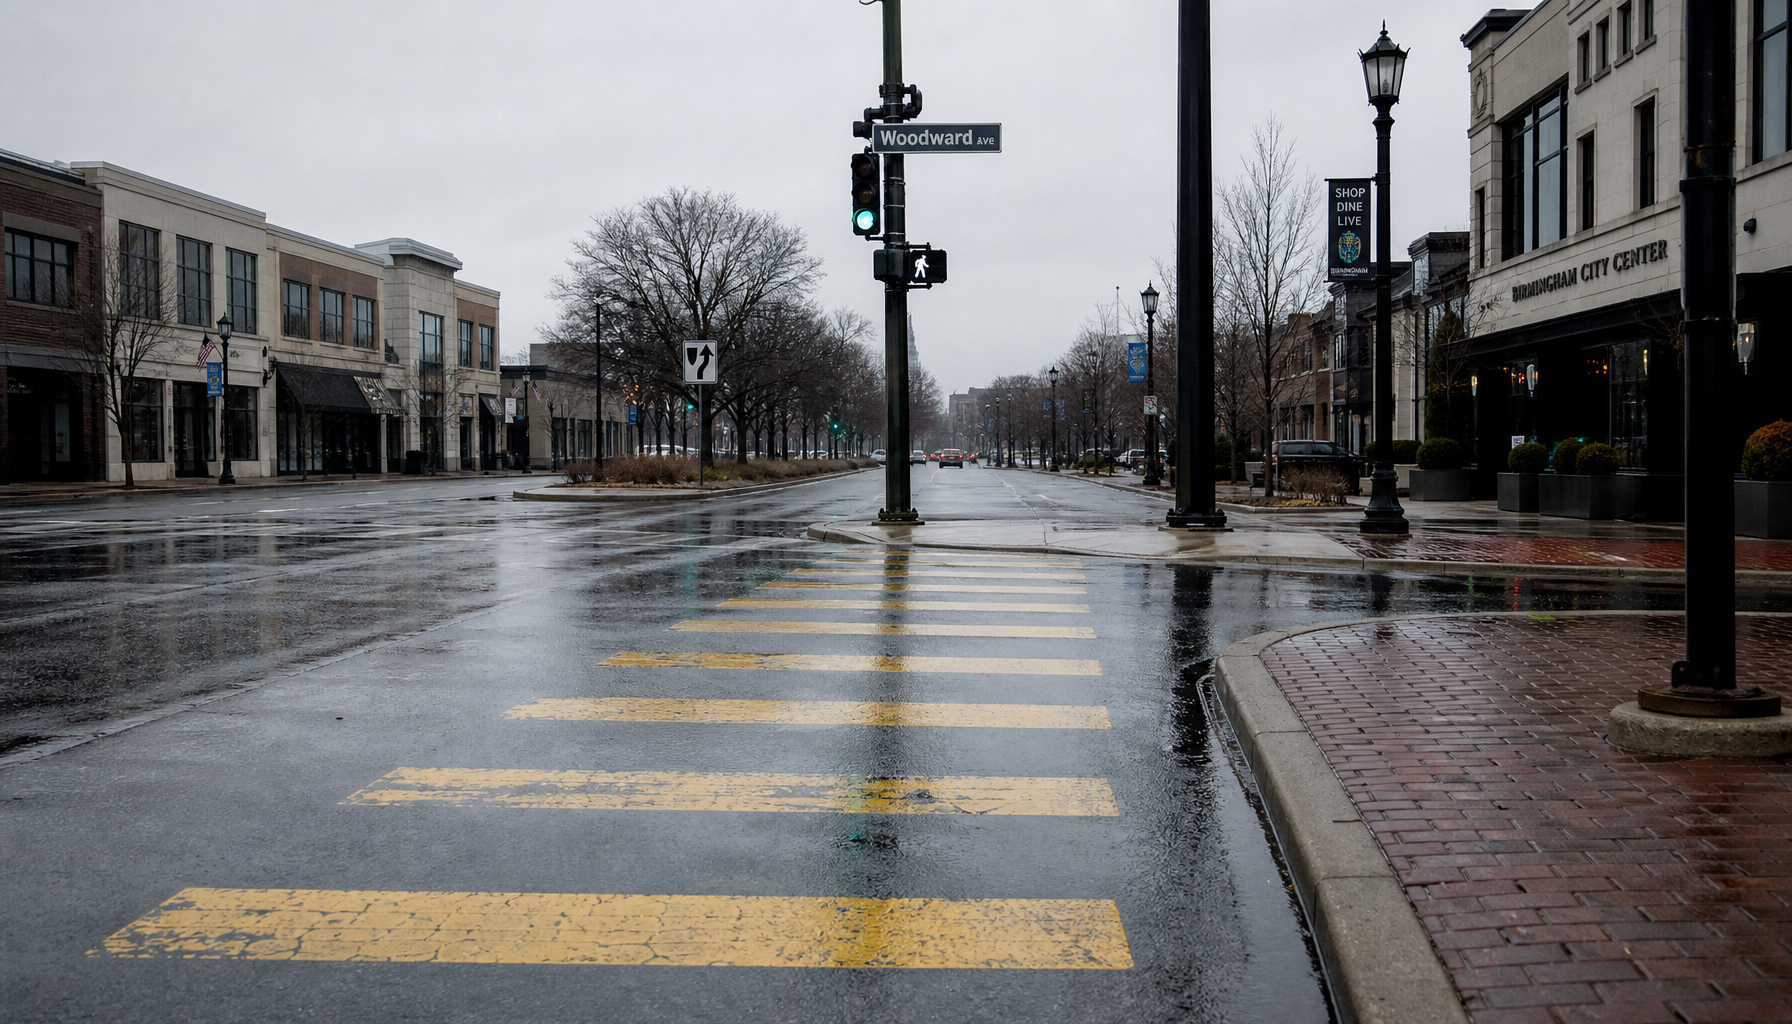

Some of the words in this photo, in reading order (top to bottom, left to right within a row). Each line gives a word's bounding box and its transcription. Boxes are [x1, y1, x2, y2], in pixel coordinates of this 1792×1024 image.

[880, 129, 973, 146] Woodward
[1335, 187, 1365, 198] SHOP
[1337, 202, 1362, 212] DINE
[1337, 216, 1362, 226] LIVE
[1512, 267, 1577, 303] BIRMINGHAM
[1580, 257, 1610, 282] CITY
[1612, 239, 1669, 272] CENTER
